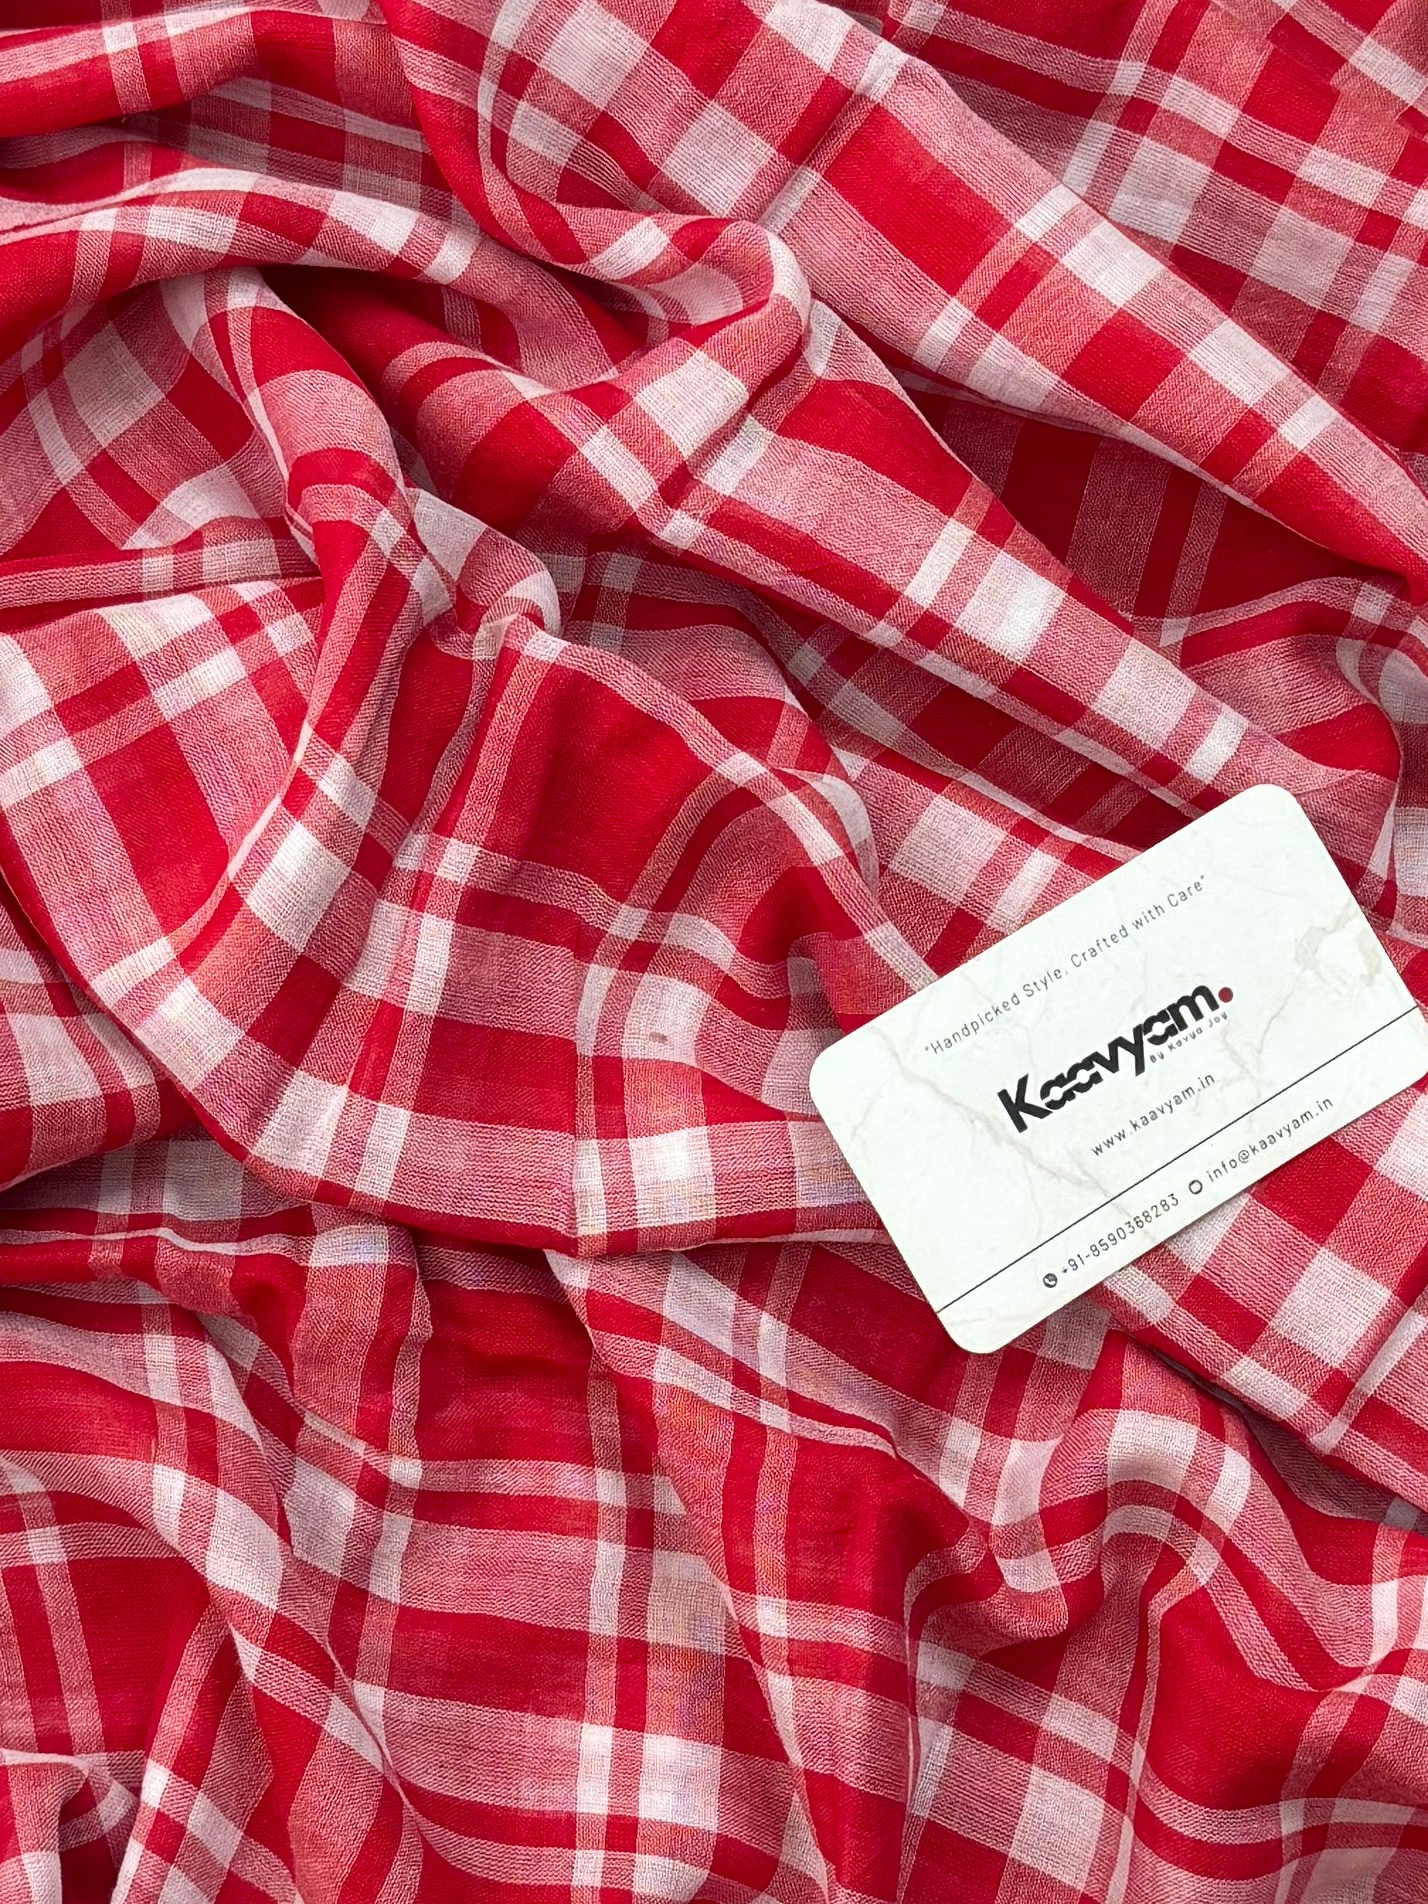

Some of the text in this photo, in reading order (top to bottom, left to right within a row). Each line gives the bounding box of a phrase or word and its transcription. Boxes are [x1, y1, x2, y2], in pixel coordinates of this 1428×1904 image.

[925, 993, 1020, 1054] "Handpicked
[1023, 969, 1068, 998] Style,
[1071, 925, 1128, 967] Crafted
[1132, 905, 1165, 929] with
[997, 985, 1233, 1133] Kaavyam.
[1091, 1075, 1215, 1156] www.kaavyam.in
[1062, 1099, 1334, 1273] +91-8590368283 info@kaavyam.in
